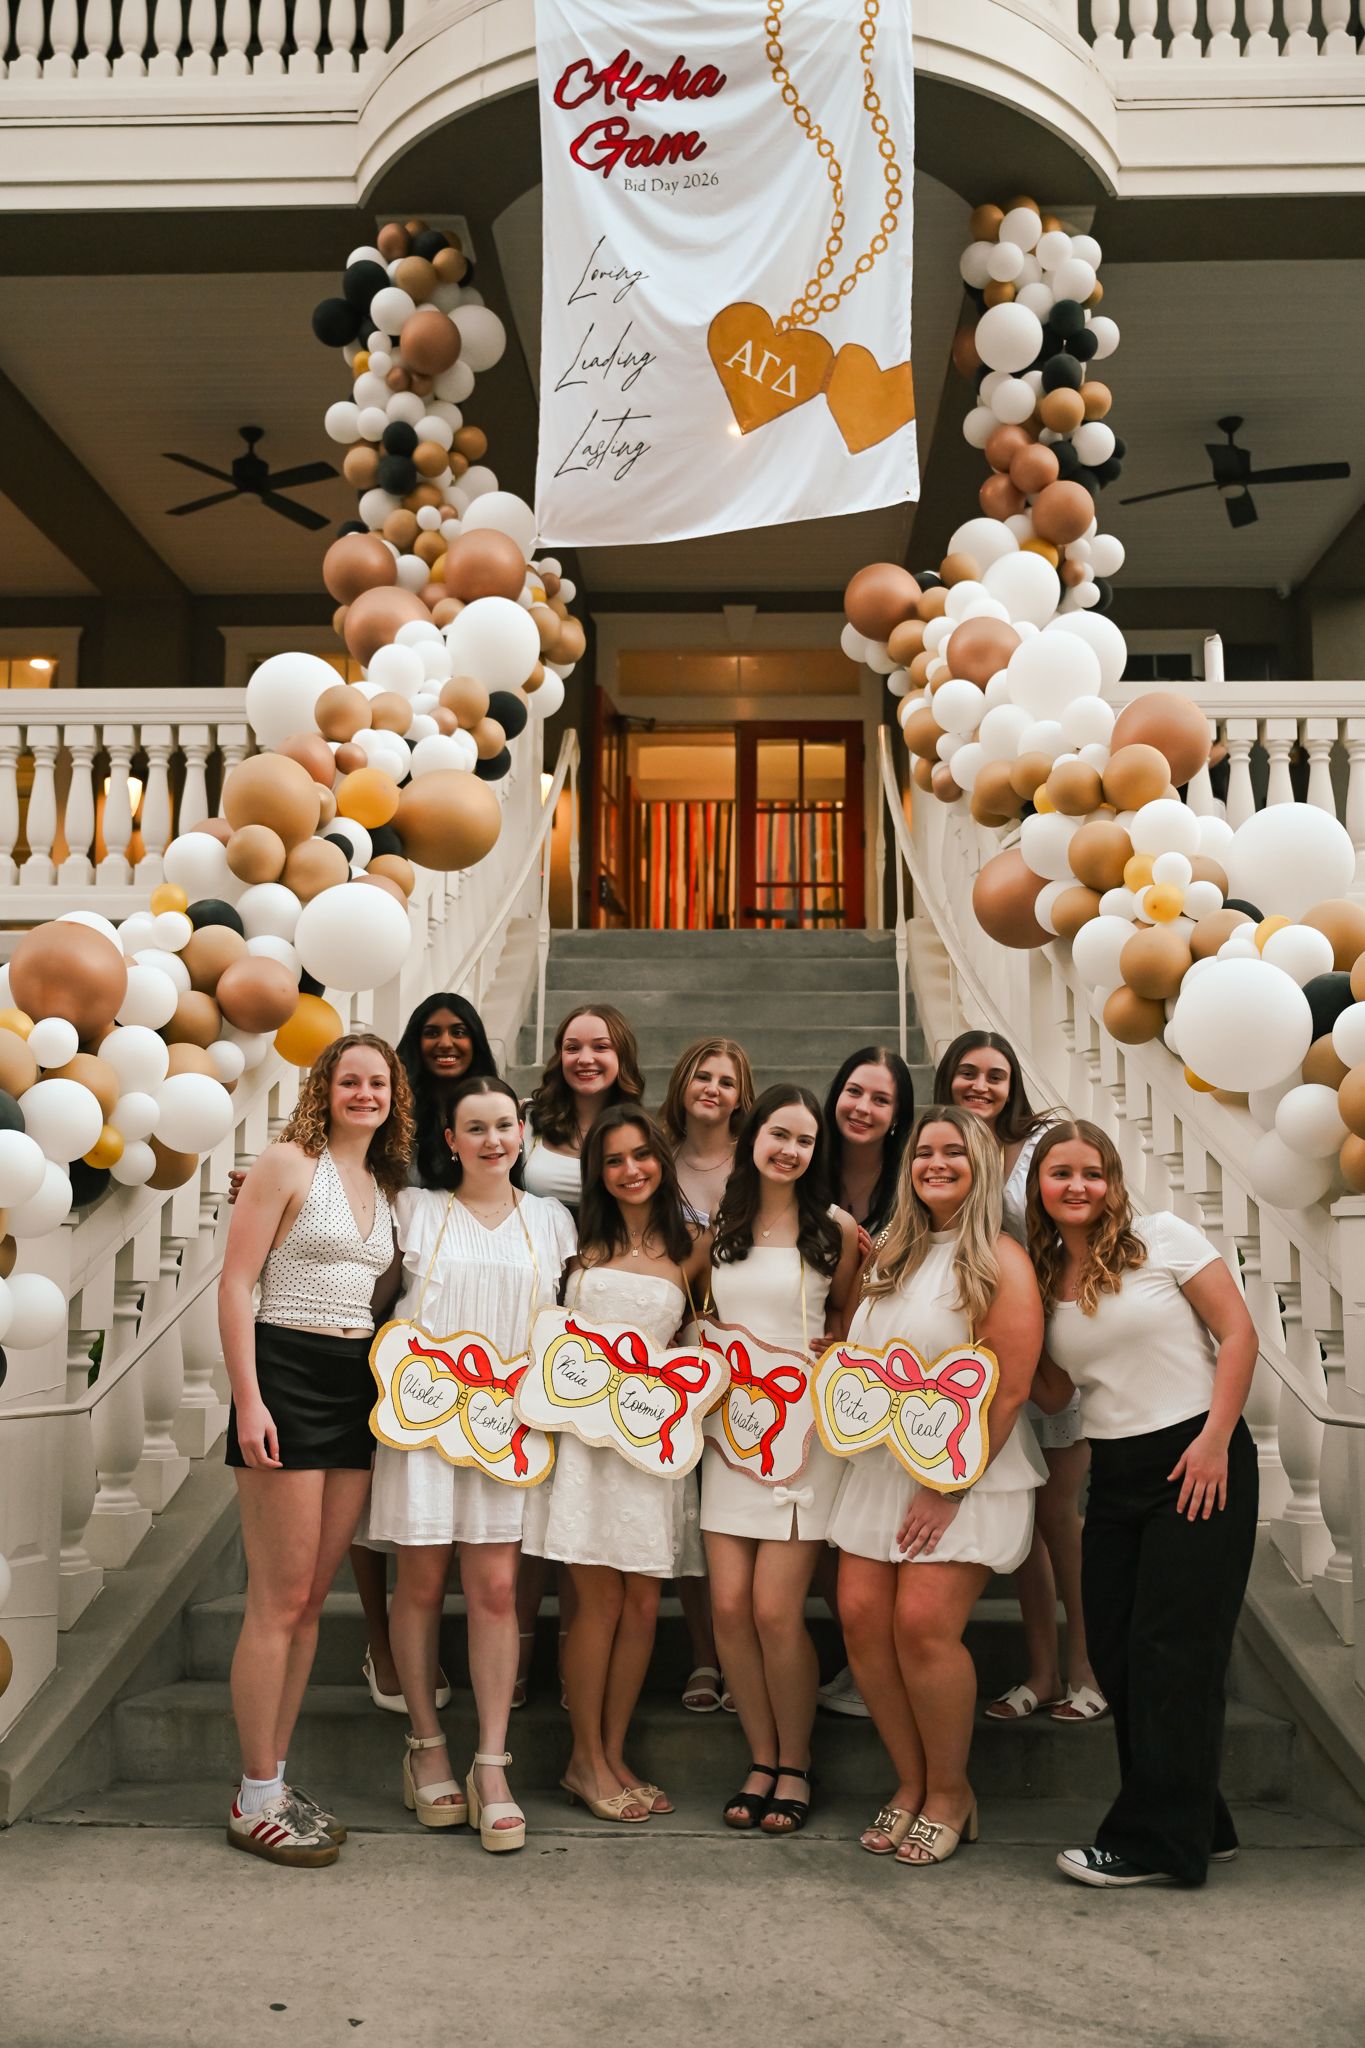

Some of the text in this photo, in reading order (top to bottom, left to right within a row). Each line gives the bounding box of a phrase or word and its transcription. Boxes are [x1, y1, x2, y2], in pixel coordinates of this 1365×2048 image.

[553, 49, 727, 112] Alpha
[569, 116, 707, 178] Gam
[623, 172, 719, 195] Bid Day 2026
[568, 235, 650, 305] Loving
[555, 321, 657, 392] Leading
[554, 408, 652, 481] Lasting
[556, 1355, 587, 1388] Kaia
[402, 1373, 444, 1409] Violet
[620, 1390, 666, 1421] Loomis
[834, 1388, 870, 1424] Rita
[470, 1405, 515, 1437] Lorish
[905, 1410, 947, 1439] Teal
